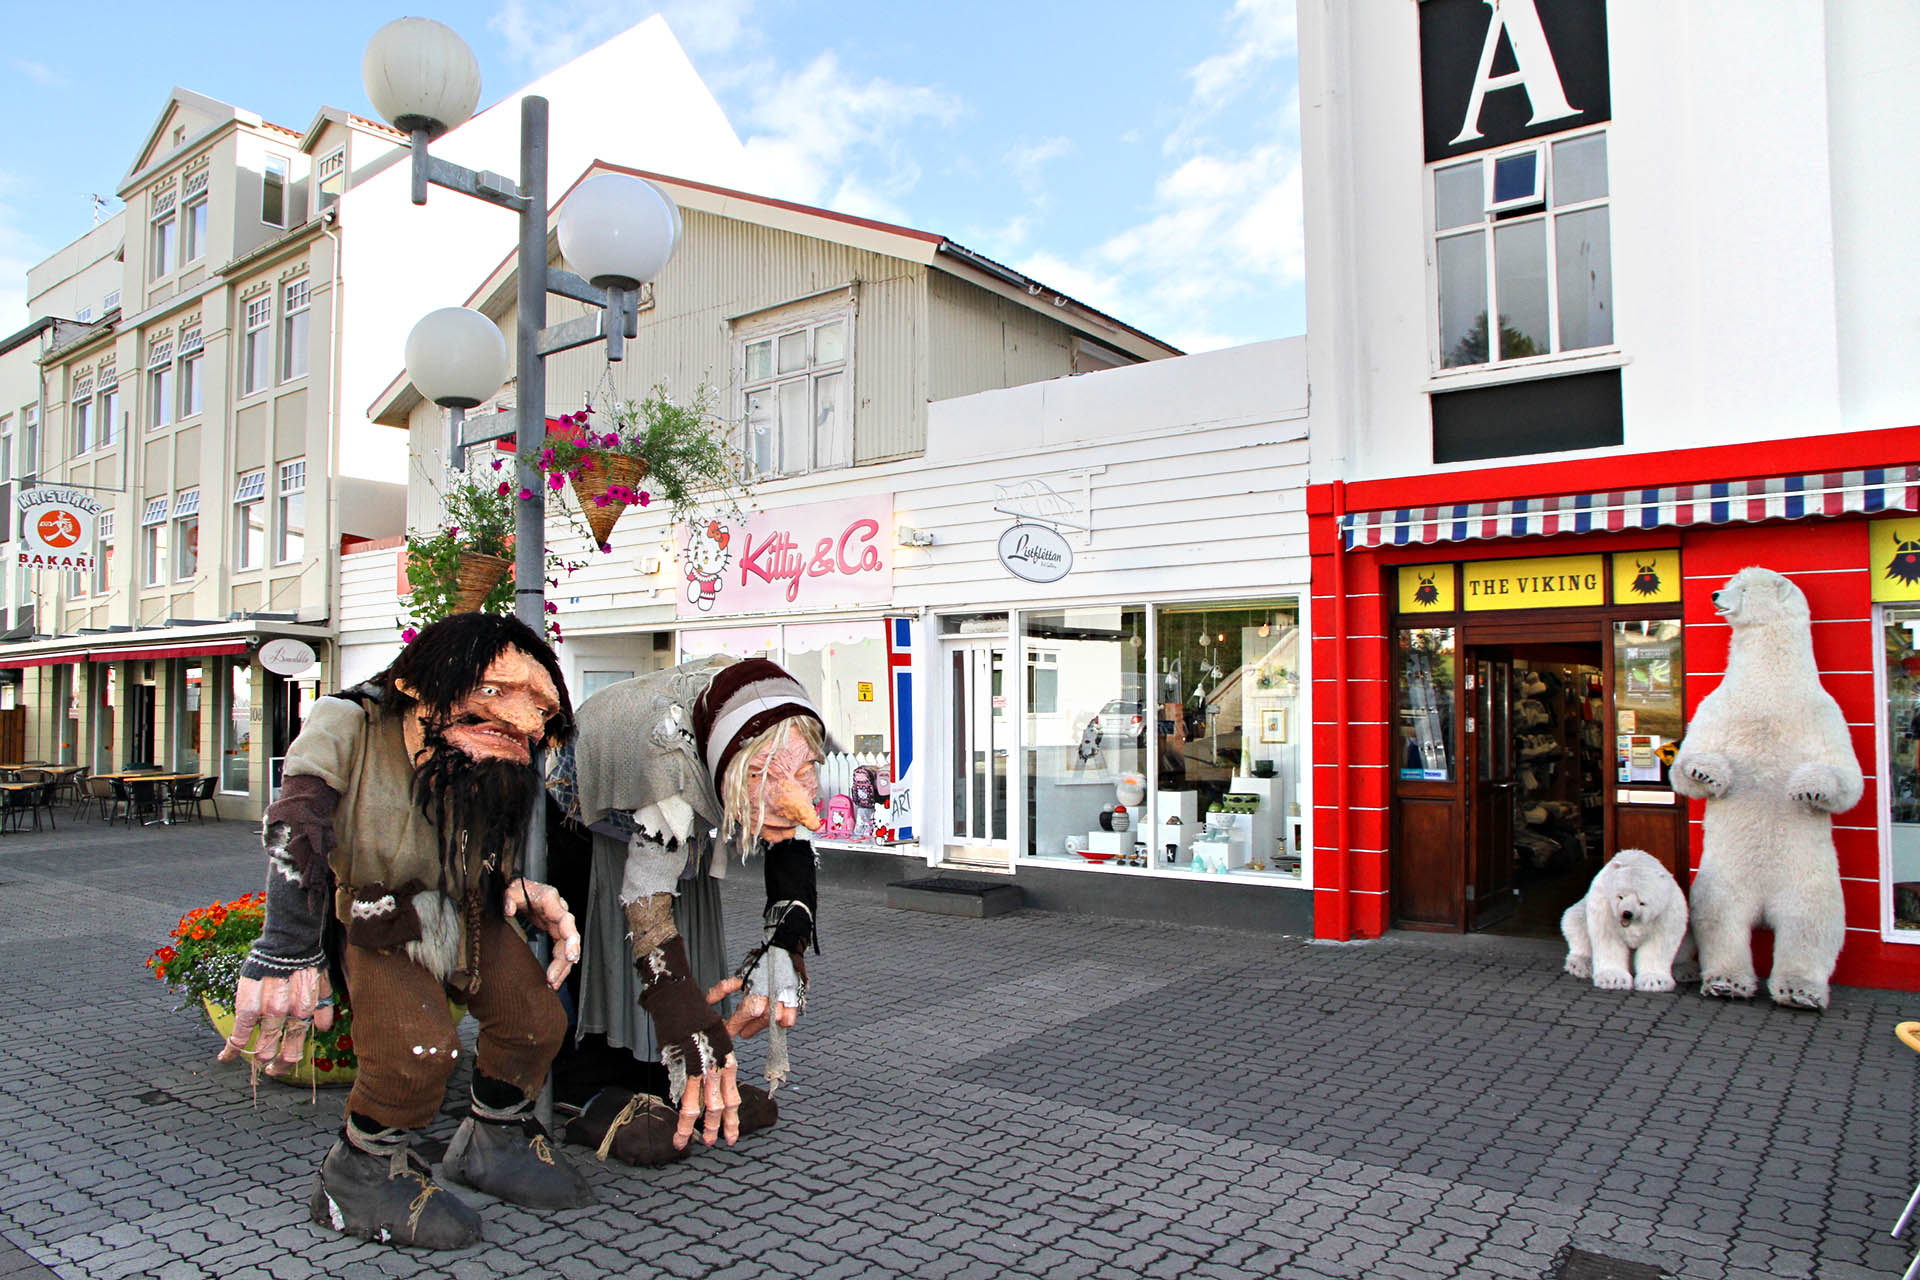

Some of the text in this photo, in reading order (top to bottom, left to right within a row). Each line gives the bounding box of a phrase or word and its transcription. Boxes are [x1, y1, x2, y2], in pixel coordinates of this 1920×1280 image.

[1448, 0, 1584, 146] A
[739, 518, 883, 602] Kitty & Co.
[1469, 574, 1597, 595] THE VIKING
[892, 788, 911, 822] ART
